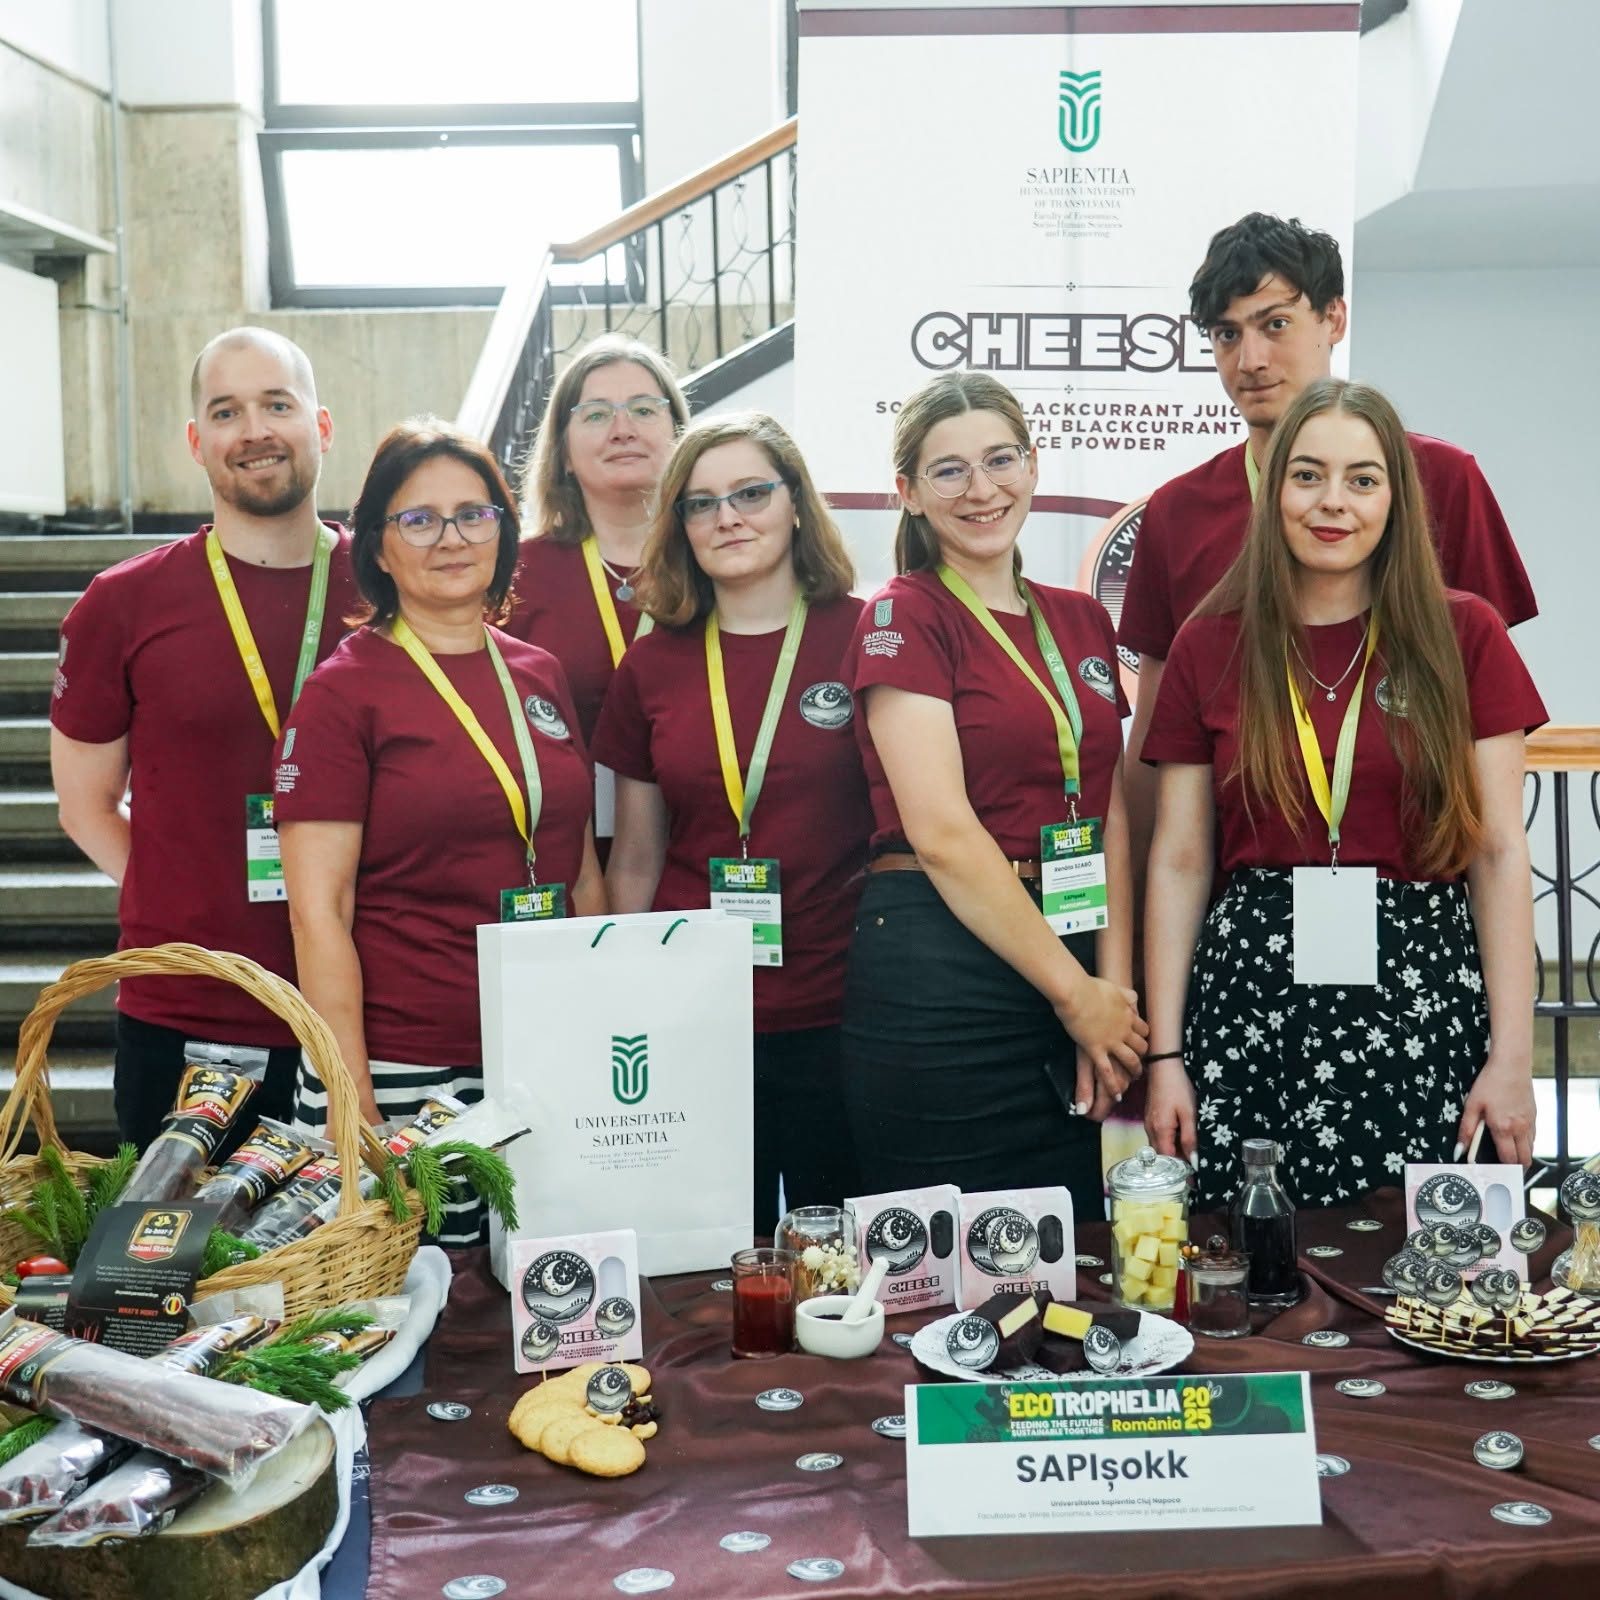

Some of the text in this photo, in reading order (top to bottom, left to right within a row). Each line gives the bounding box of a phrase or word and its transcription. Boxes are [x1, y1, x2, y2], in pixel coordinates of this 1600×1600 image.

[1026, 168, 1130, 184] SAPIENTIA
[1034, 200, 1121, 208] OF TRANSYLVANIA
[911, 311, 1218, 373] CHEESE
[876, 401, 1241, 417] SO LACKCURRANT JUIC
[1026, 419, 1241, 434] TH BLACKCURRANT
[1036, 436, 1166, 450] CE POWDER
[864, 630, 903, 640] SAPIENTIA
[575, 1111, 686, 1129] UNIVERSITATEA
[592, 1131, 668, 1147] SAPIENTIA
[1450, 1176, 1476, 1197] CHEESE
[895, 1210, 921, 1228] CHEESE
[526, 1252, 589, 1280] TWLIGHT CHEESE
[888, 1275, 940, 1294] CHEESE
[993, 1280, 1049, 1295] CHEESE
[559, 1329, 611, 1345] HEES
[1010, 1386, 1210, 1418] ECOTROPHELIA 20
[1010, 1419, 1104, 1429] FEEDING THE FUTURE
[1112, 1408, 1212, 1432] România 25
[1011, 1427, 1104, 1437] SUSTAINABLE TOGETHER
[1051, 1497, 1181, 1507] Universitatea Sapientia Cluj Napoca
